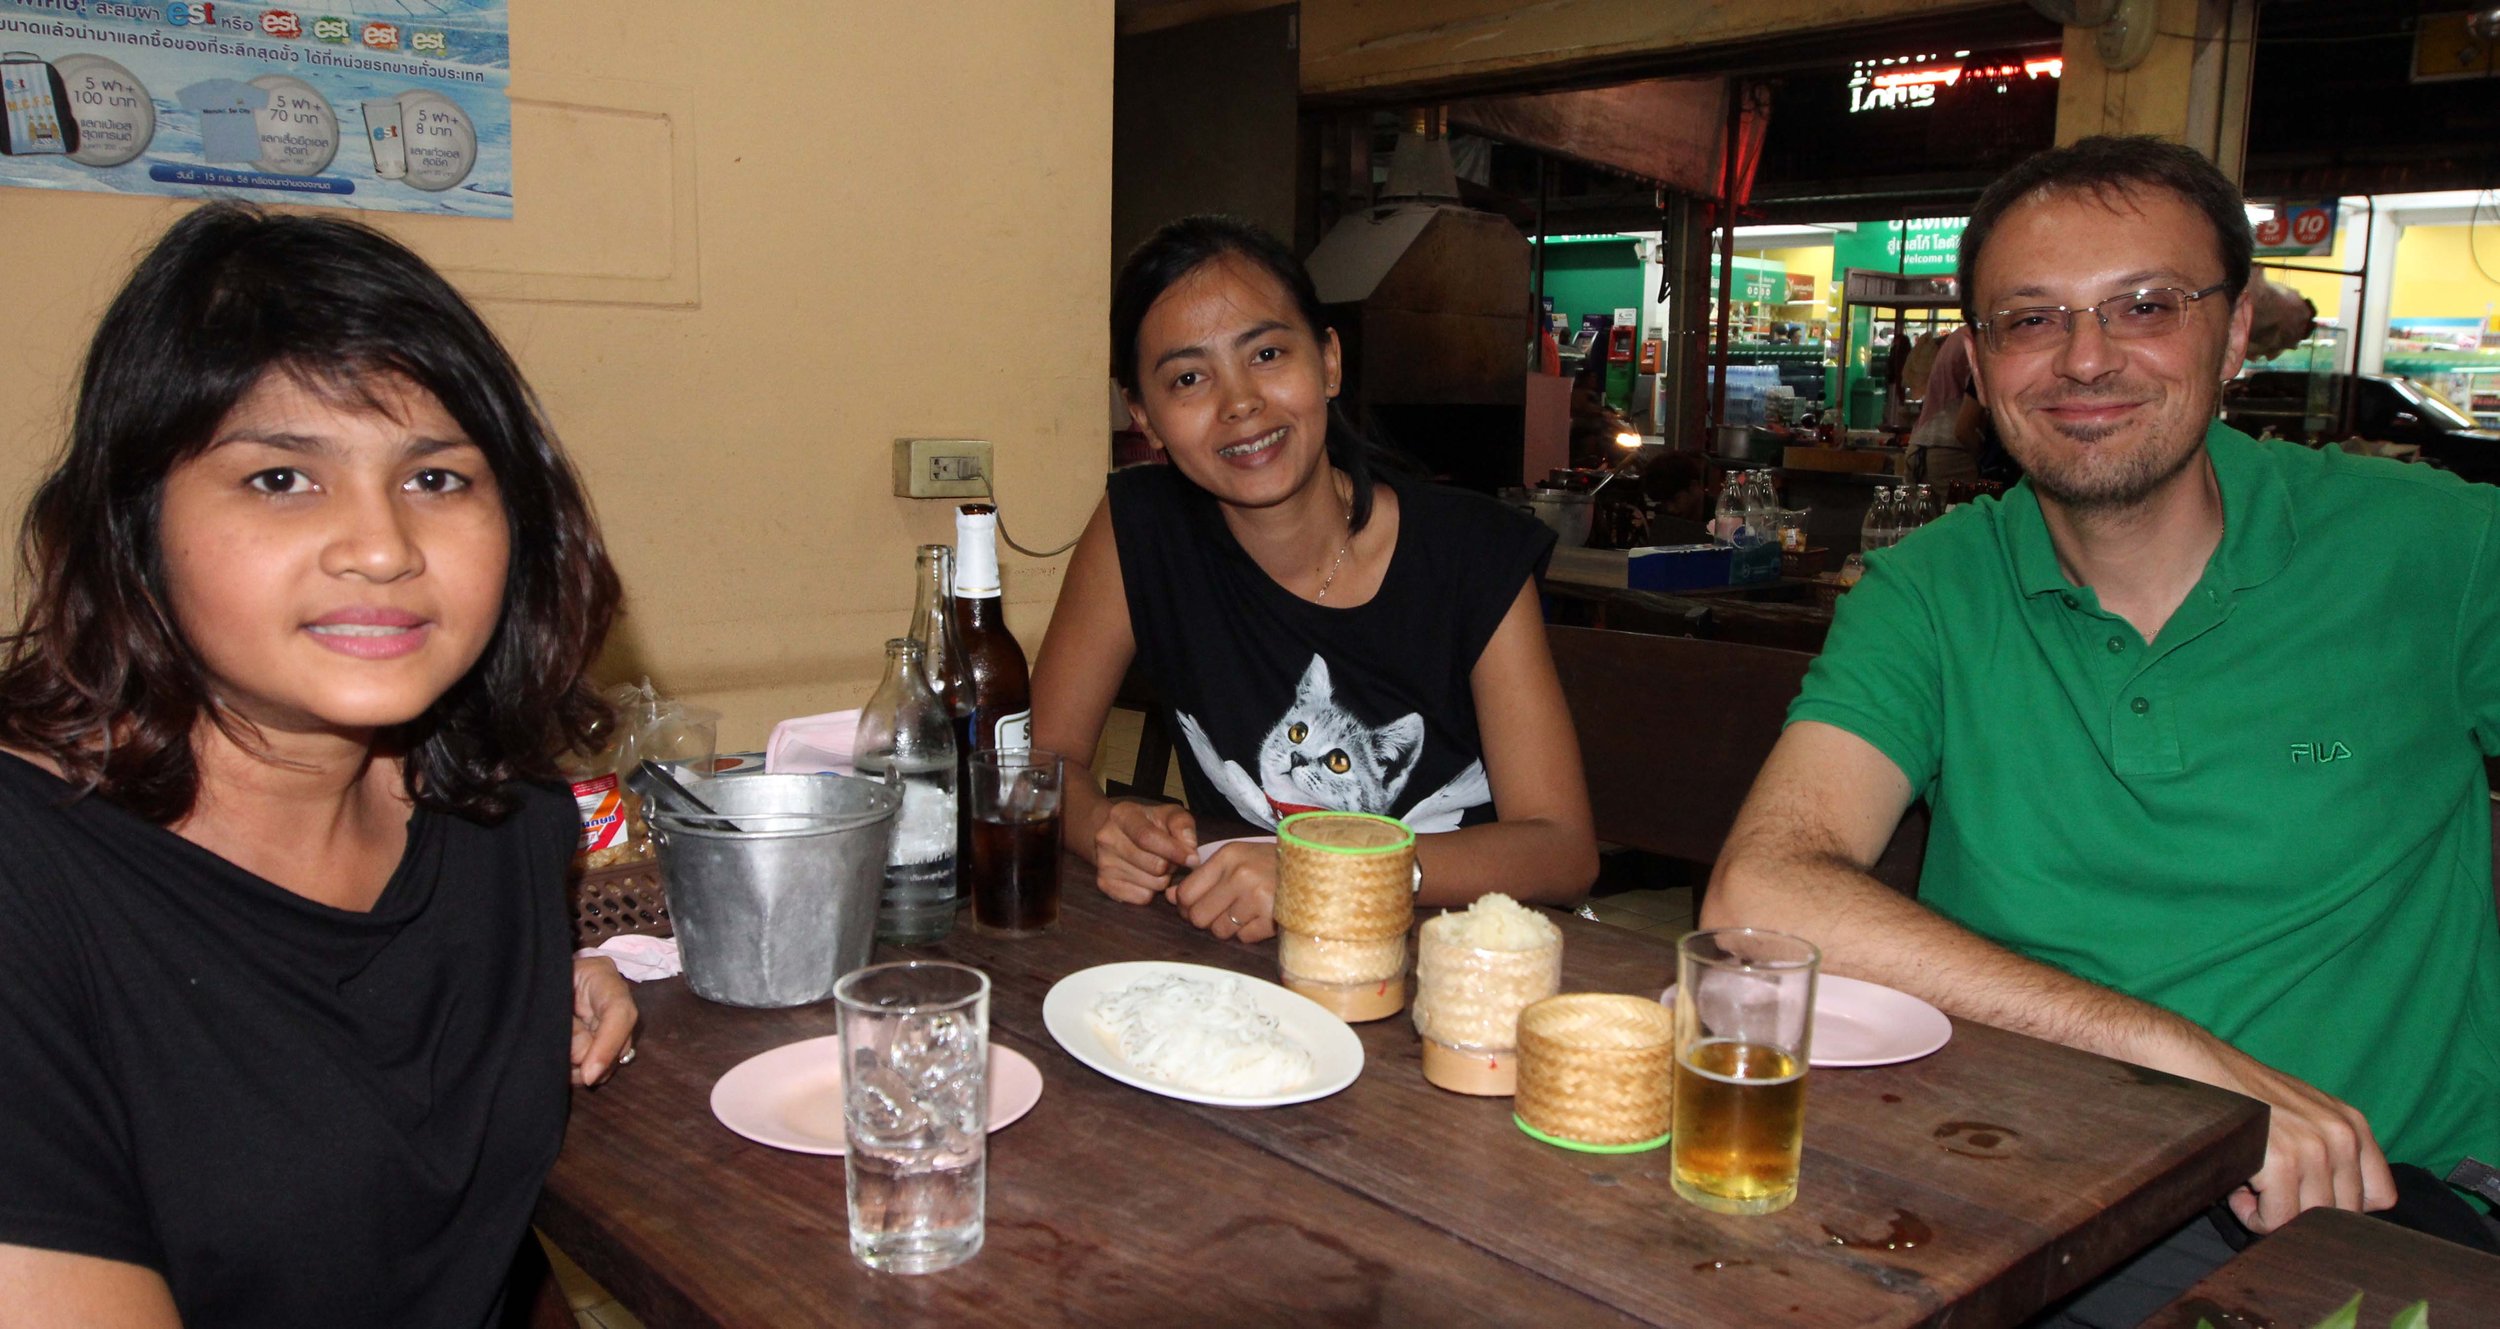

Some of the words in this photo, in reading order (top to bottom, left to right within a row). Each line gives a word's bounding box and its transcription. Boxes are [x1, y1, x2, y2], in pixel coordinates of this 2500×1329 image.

[166, 2, 216, 27] est
[221, 16, 254, 32] หรือ
[261, 11, 300, 34] est
[313, 19, 350, 39] est
[363, 25, 399, 45] est
[411, 31, 446, 51] est
[86, 77, 95, 90] 5
[74, 91, 103, 105] 100
[109, 97, 138, 108] บาท
[277, 95, 286, 108] 5
[270, 108, 288, 121] 70
[294, 114, 319, 124] บาท
[418, 109, 427, 122] 5
[373, 125, 399, 141] est
[416, 122, 424, 134] 8
[430, 125, 453, 137] บาท
[204, 173, 215, 181] 15
[2298, 214, 2325, 235] 10
[1900, 253, 1943, 264] Welcome
[1945, 253, 1957, 264] to
[2290, 741, 2352, 764] FILA
